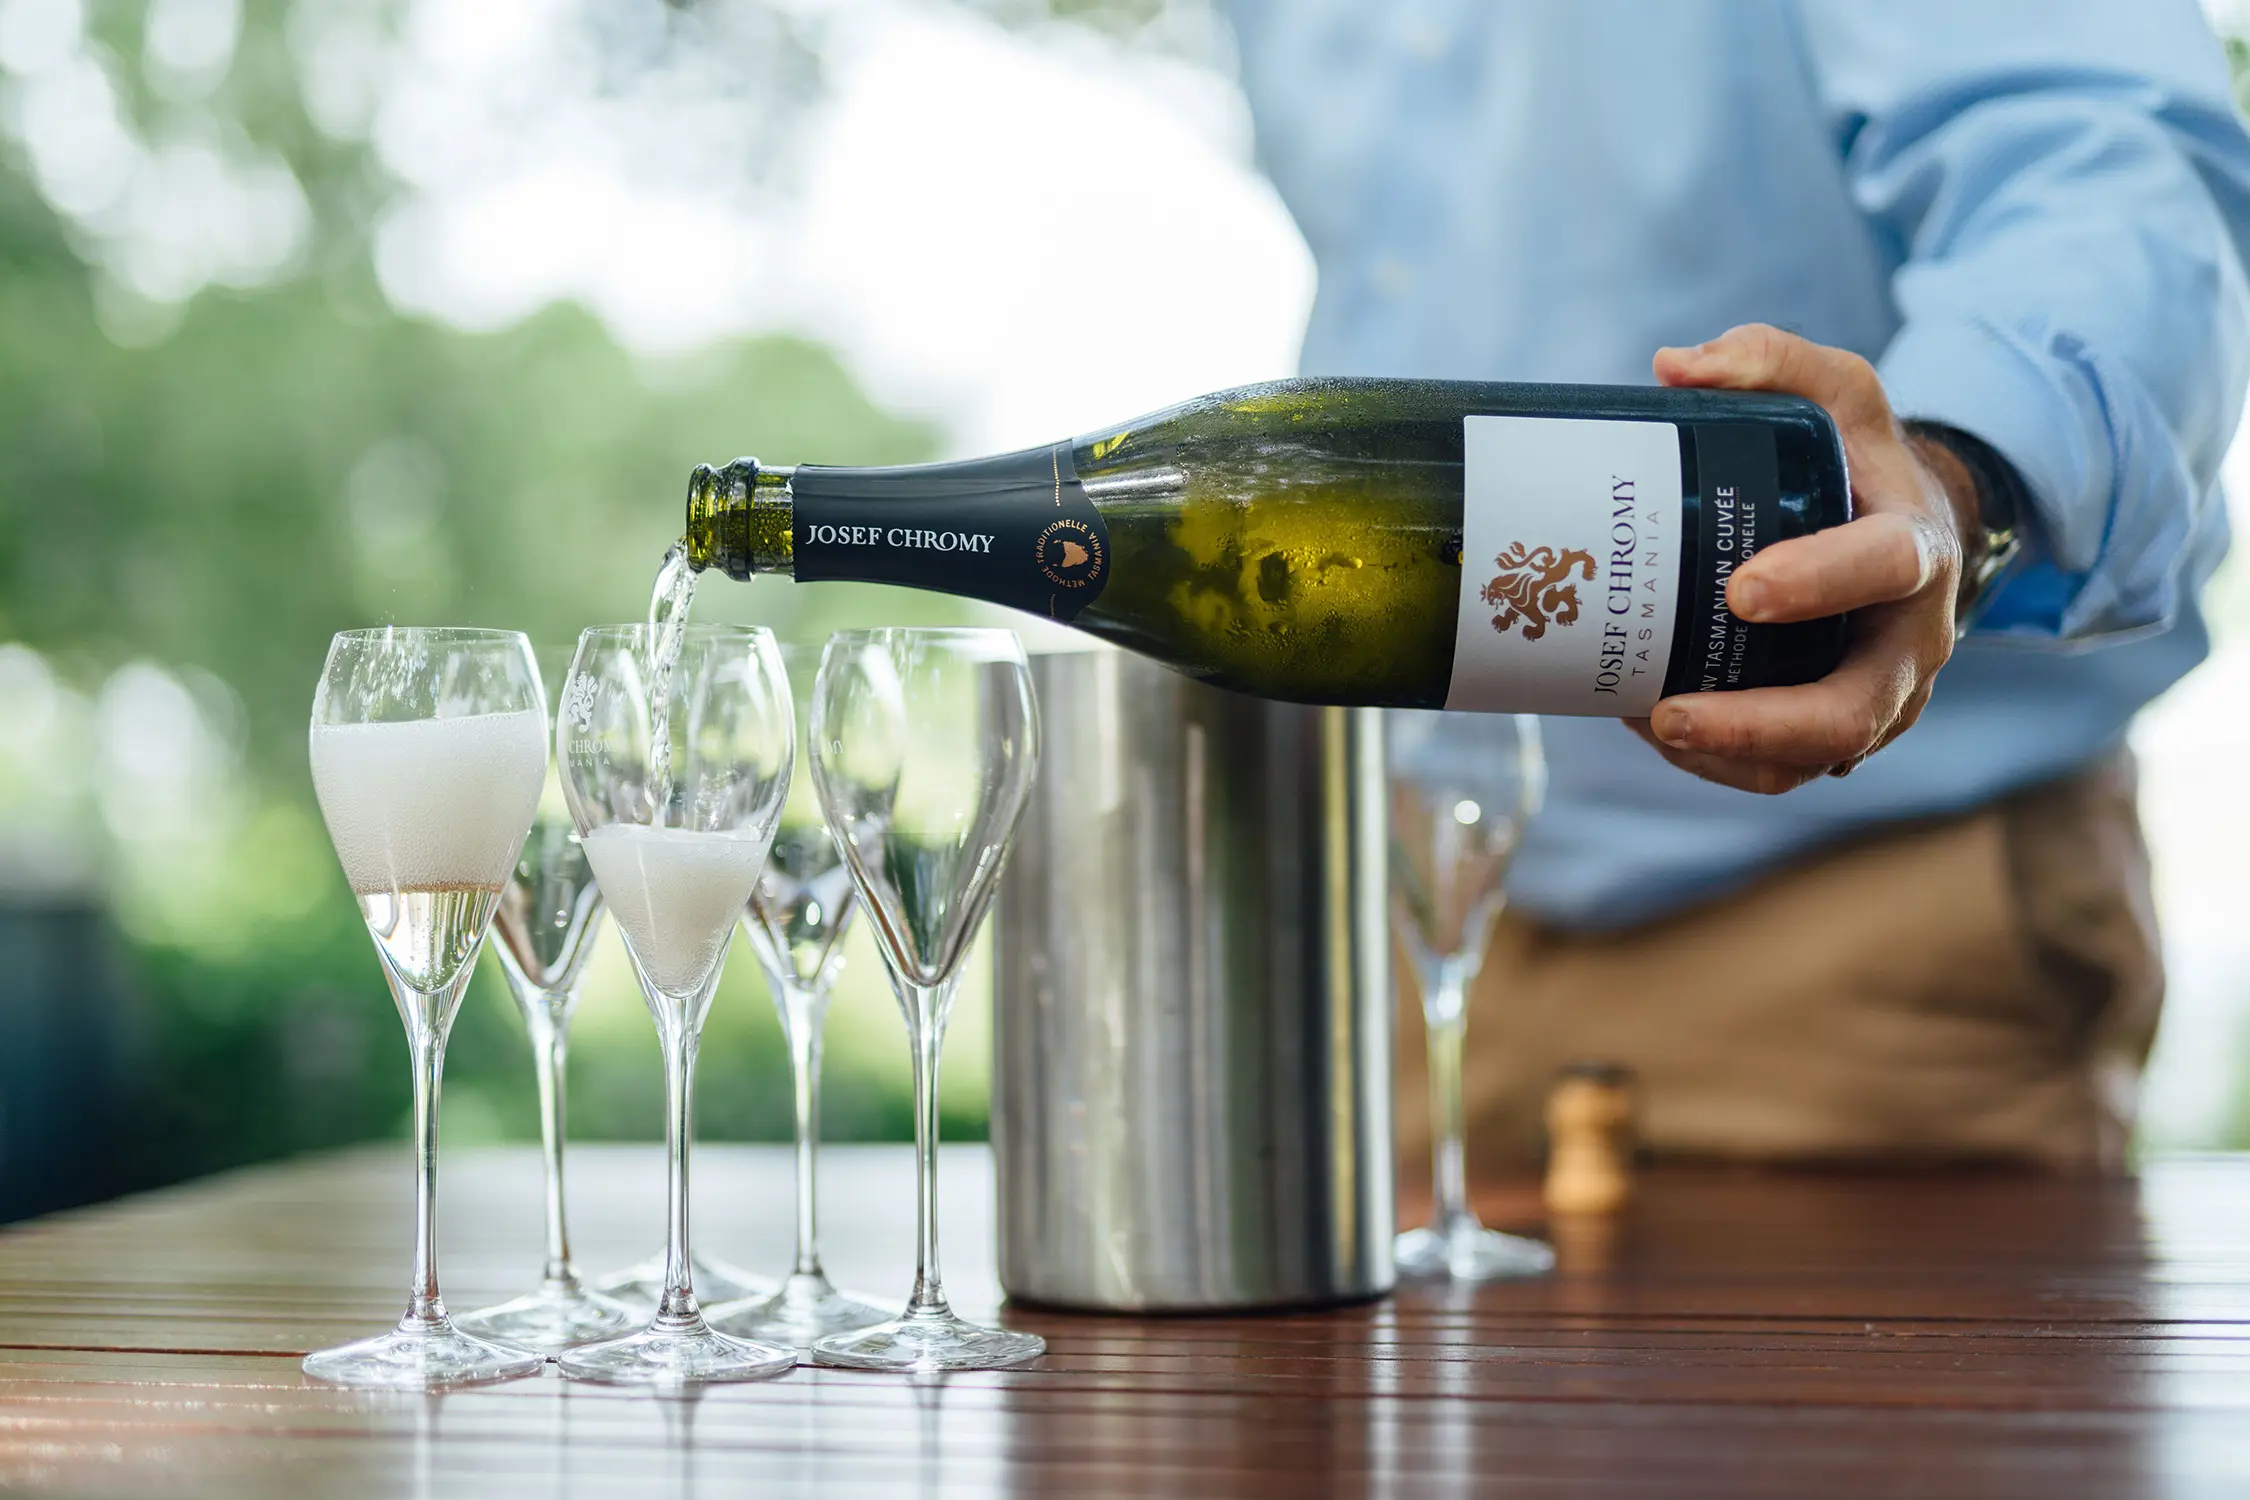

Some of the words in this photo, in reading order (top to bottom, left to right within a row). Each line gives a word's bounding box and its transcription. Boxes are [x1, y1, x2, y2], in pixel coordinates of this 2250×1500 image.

[805, 525, 883, 546] JOSEF
[887, 528, 995, 553] CHROMY
[1036, 519, 1088, 564] TRADITIONELLE
[1607, 475, 1637, 615] CHROMY
[1713, 486, 1735, 551] CUVÉE
[1087, 531, 1103, 580] TASMANIA
[1631, 511, 1660, 676] TASMANIA
[1705, 560, 1733, 669] TASMANIAN
[1594, 622, 1628, 696] JOSEF
[1700, 674, 1719, 692] NV
